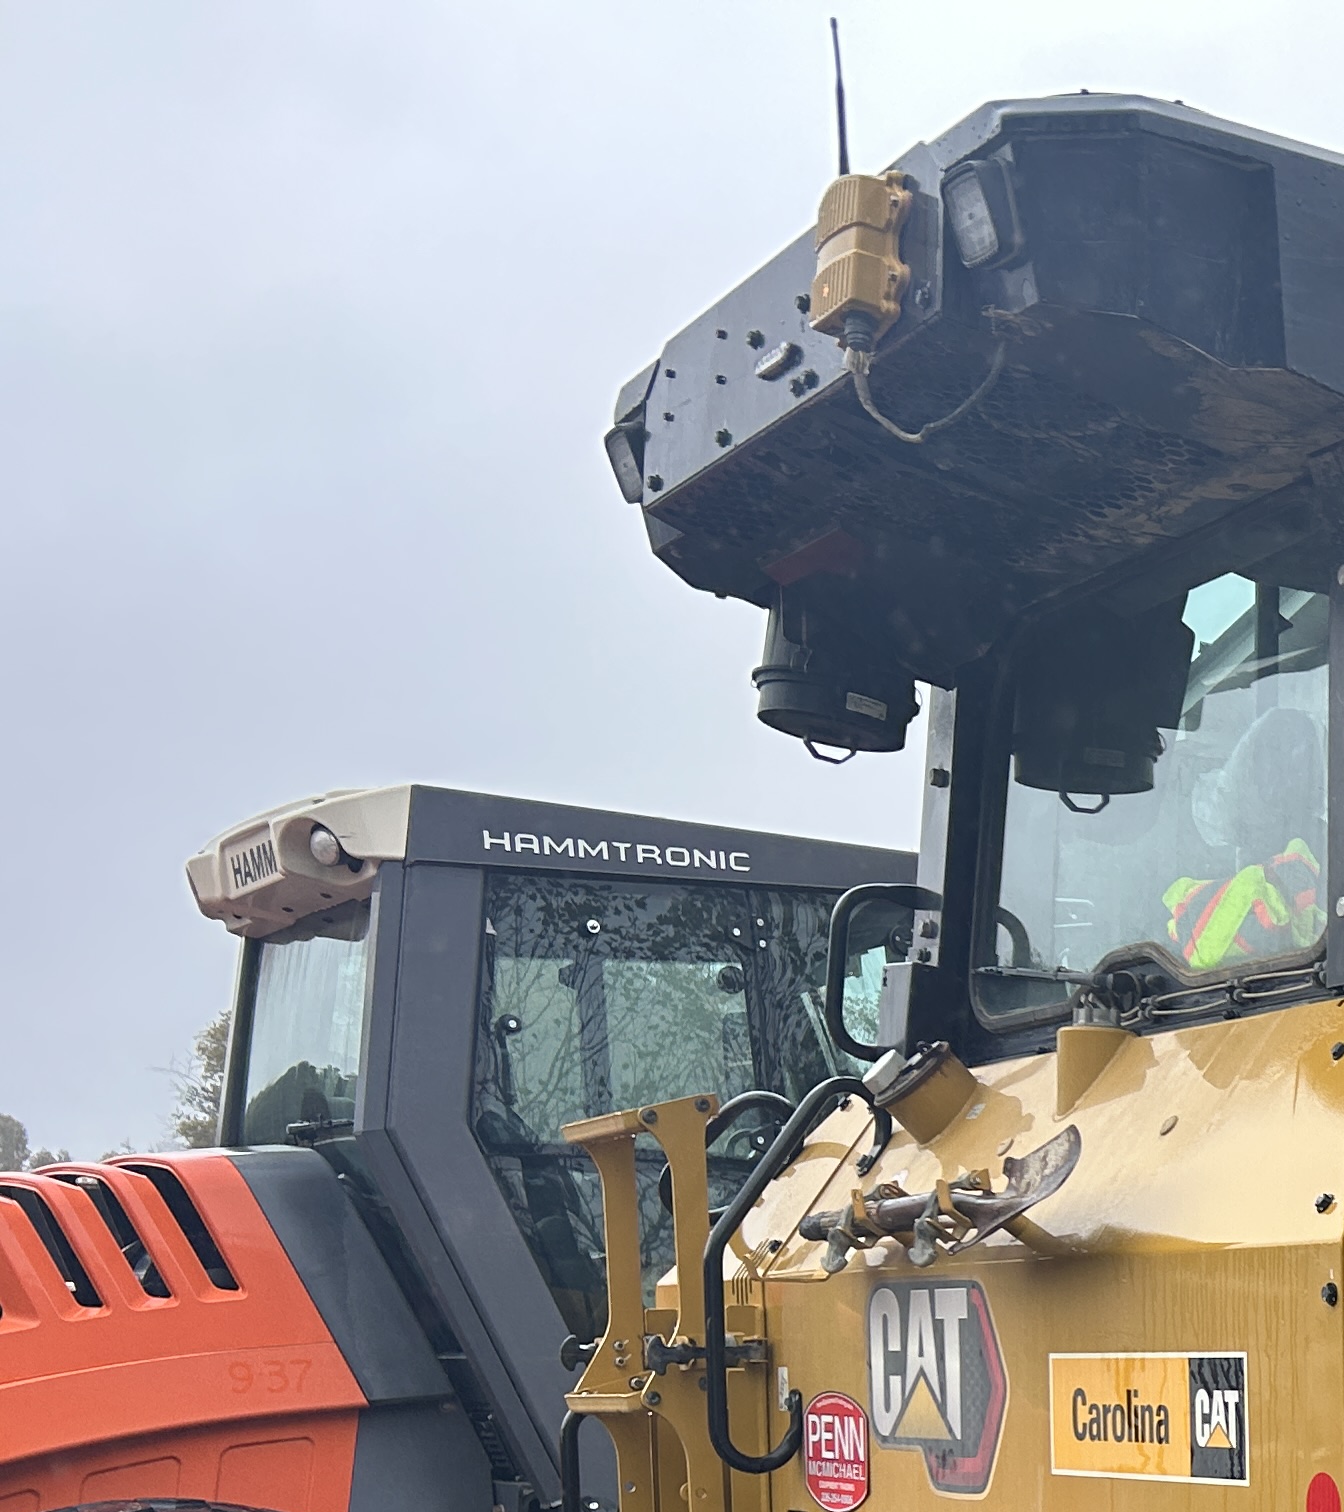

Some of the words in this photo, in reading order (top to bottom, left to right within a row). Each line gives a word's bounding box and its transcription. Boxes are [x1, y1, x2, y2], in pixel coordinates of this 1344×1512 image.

[231, 839, 278, 890] HAMM
[482, 829, 751, 872] HAMMTRONIC
[869, 1287, 968, 1440] CAT
[807, 1413, 864, 1462] PENN
[1072, 1387, 1169, 1446] Carolina
[1195, 1388, 1240, 1448] CAT
[809, 1460, 866, 1480] MCMICHAEL
